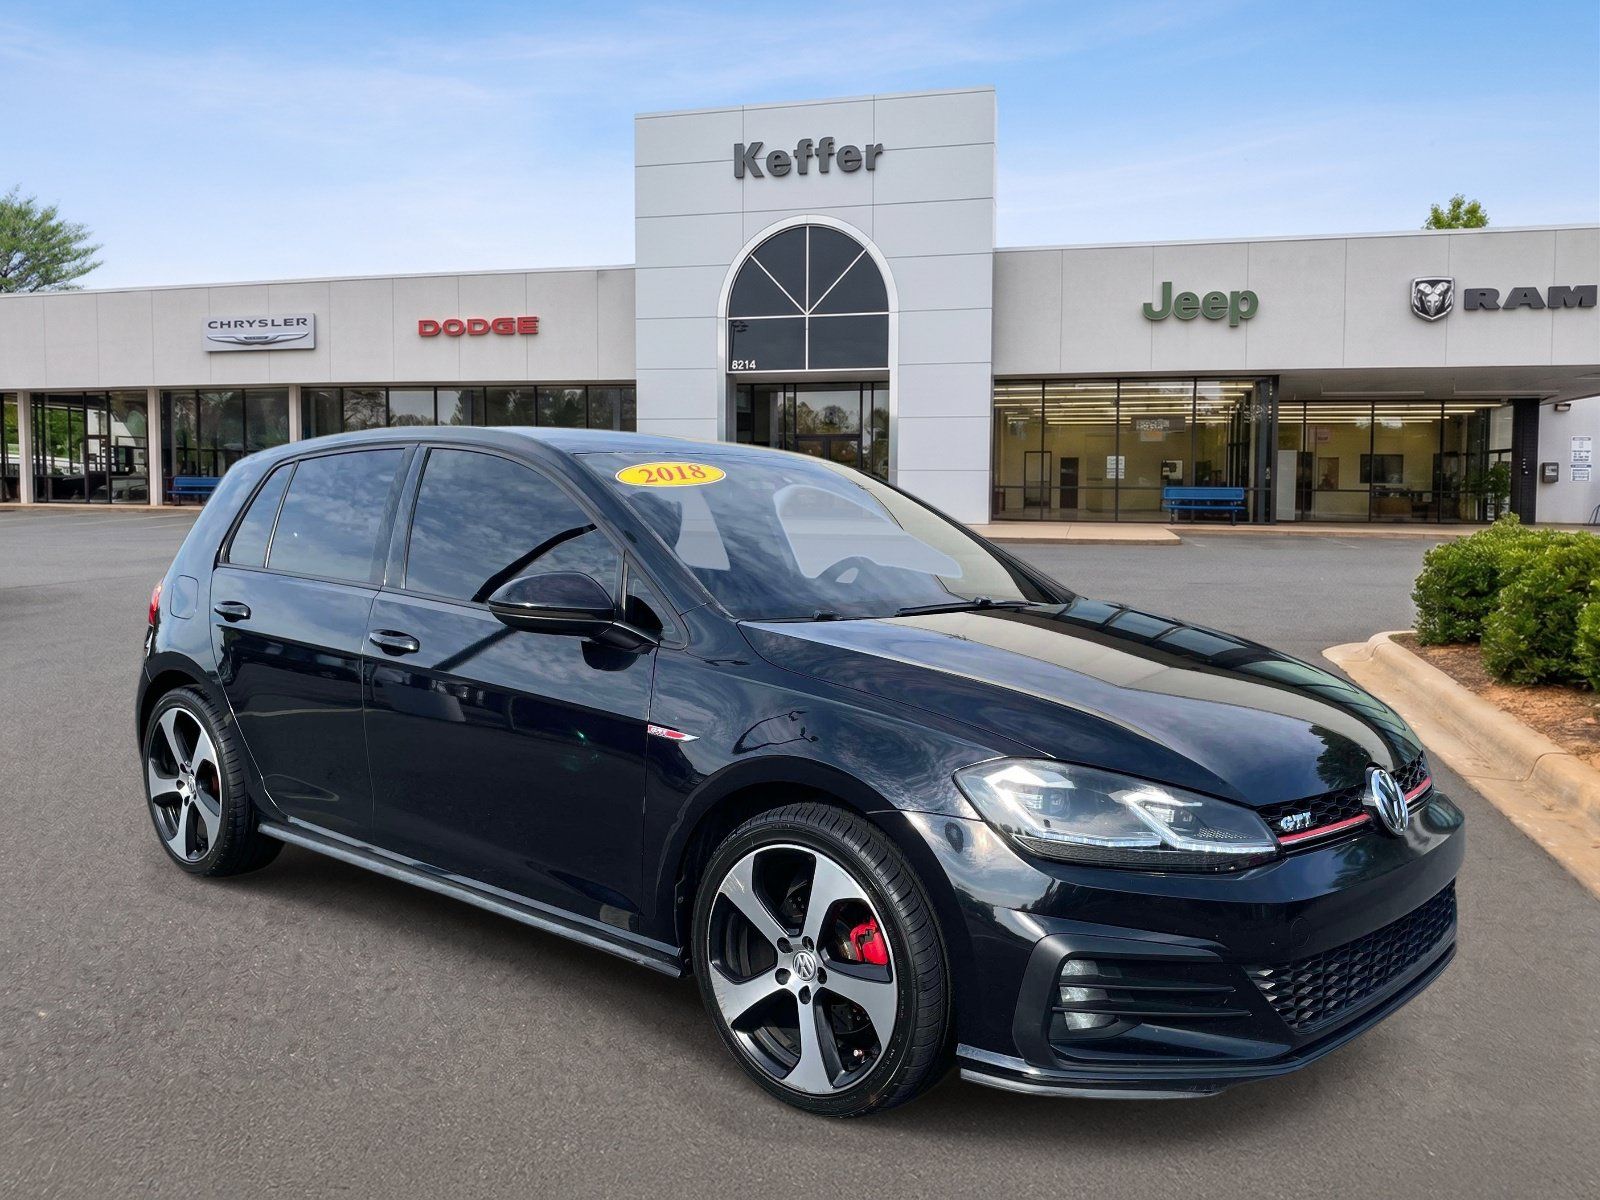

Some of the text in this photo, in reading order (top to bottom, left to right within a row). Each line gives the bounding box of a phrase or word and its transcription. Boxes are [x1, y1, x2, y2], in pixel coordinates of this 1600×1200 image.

[733, 136, 883, 179] Keffer
[1142, 281, 1259, 328] Jeep
[1464, 285, 1598, 310] RAM
[207, 317, 308, 329] CHRYSLER
[418, 316, 539, 337] DODGE
[731, 359, 756, 370] 8214
[638, 464, 706, 483] 2018
[1280, 811, 1311, 832] GTI
